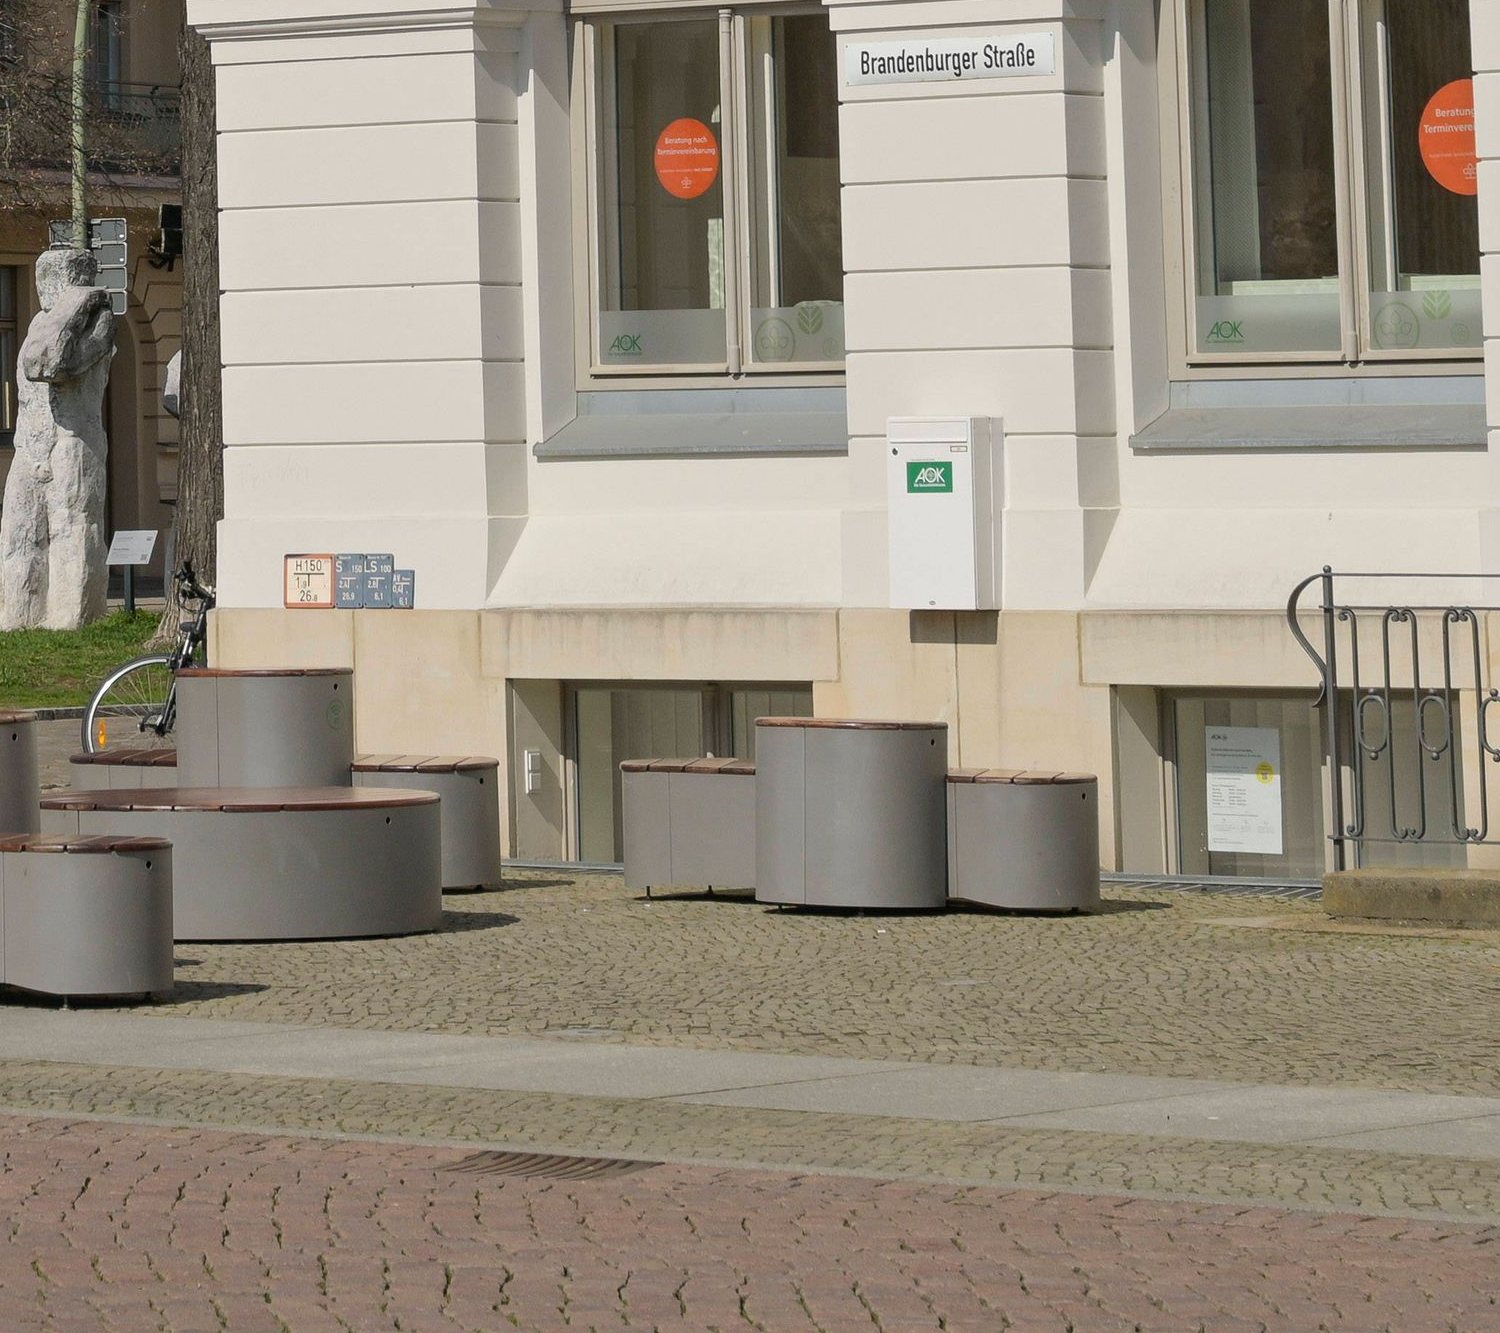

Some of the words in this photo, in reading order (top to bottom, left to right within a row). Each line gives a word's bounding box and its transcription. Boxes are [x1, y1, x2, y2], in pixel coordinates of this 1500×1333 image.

[860, 49, 979, 77] Brandenburger
[983, 42, 1036, 69] Straße
[664, 137, 692, 145] Beratung
[1207, 321, 1244, 339] AOK
[609, 334, 642, 351] AOK
[914, 467, 946, 483] AOK
[335, 560, 343, 573] S
[351, 564, 363, 573] 150
[364, 560, 377, 573] LS
[380, 564, 391, 573] 100
